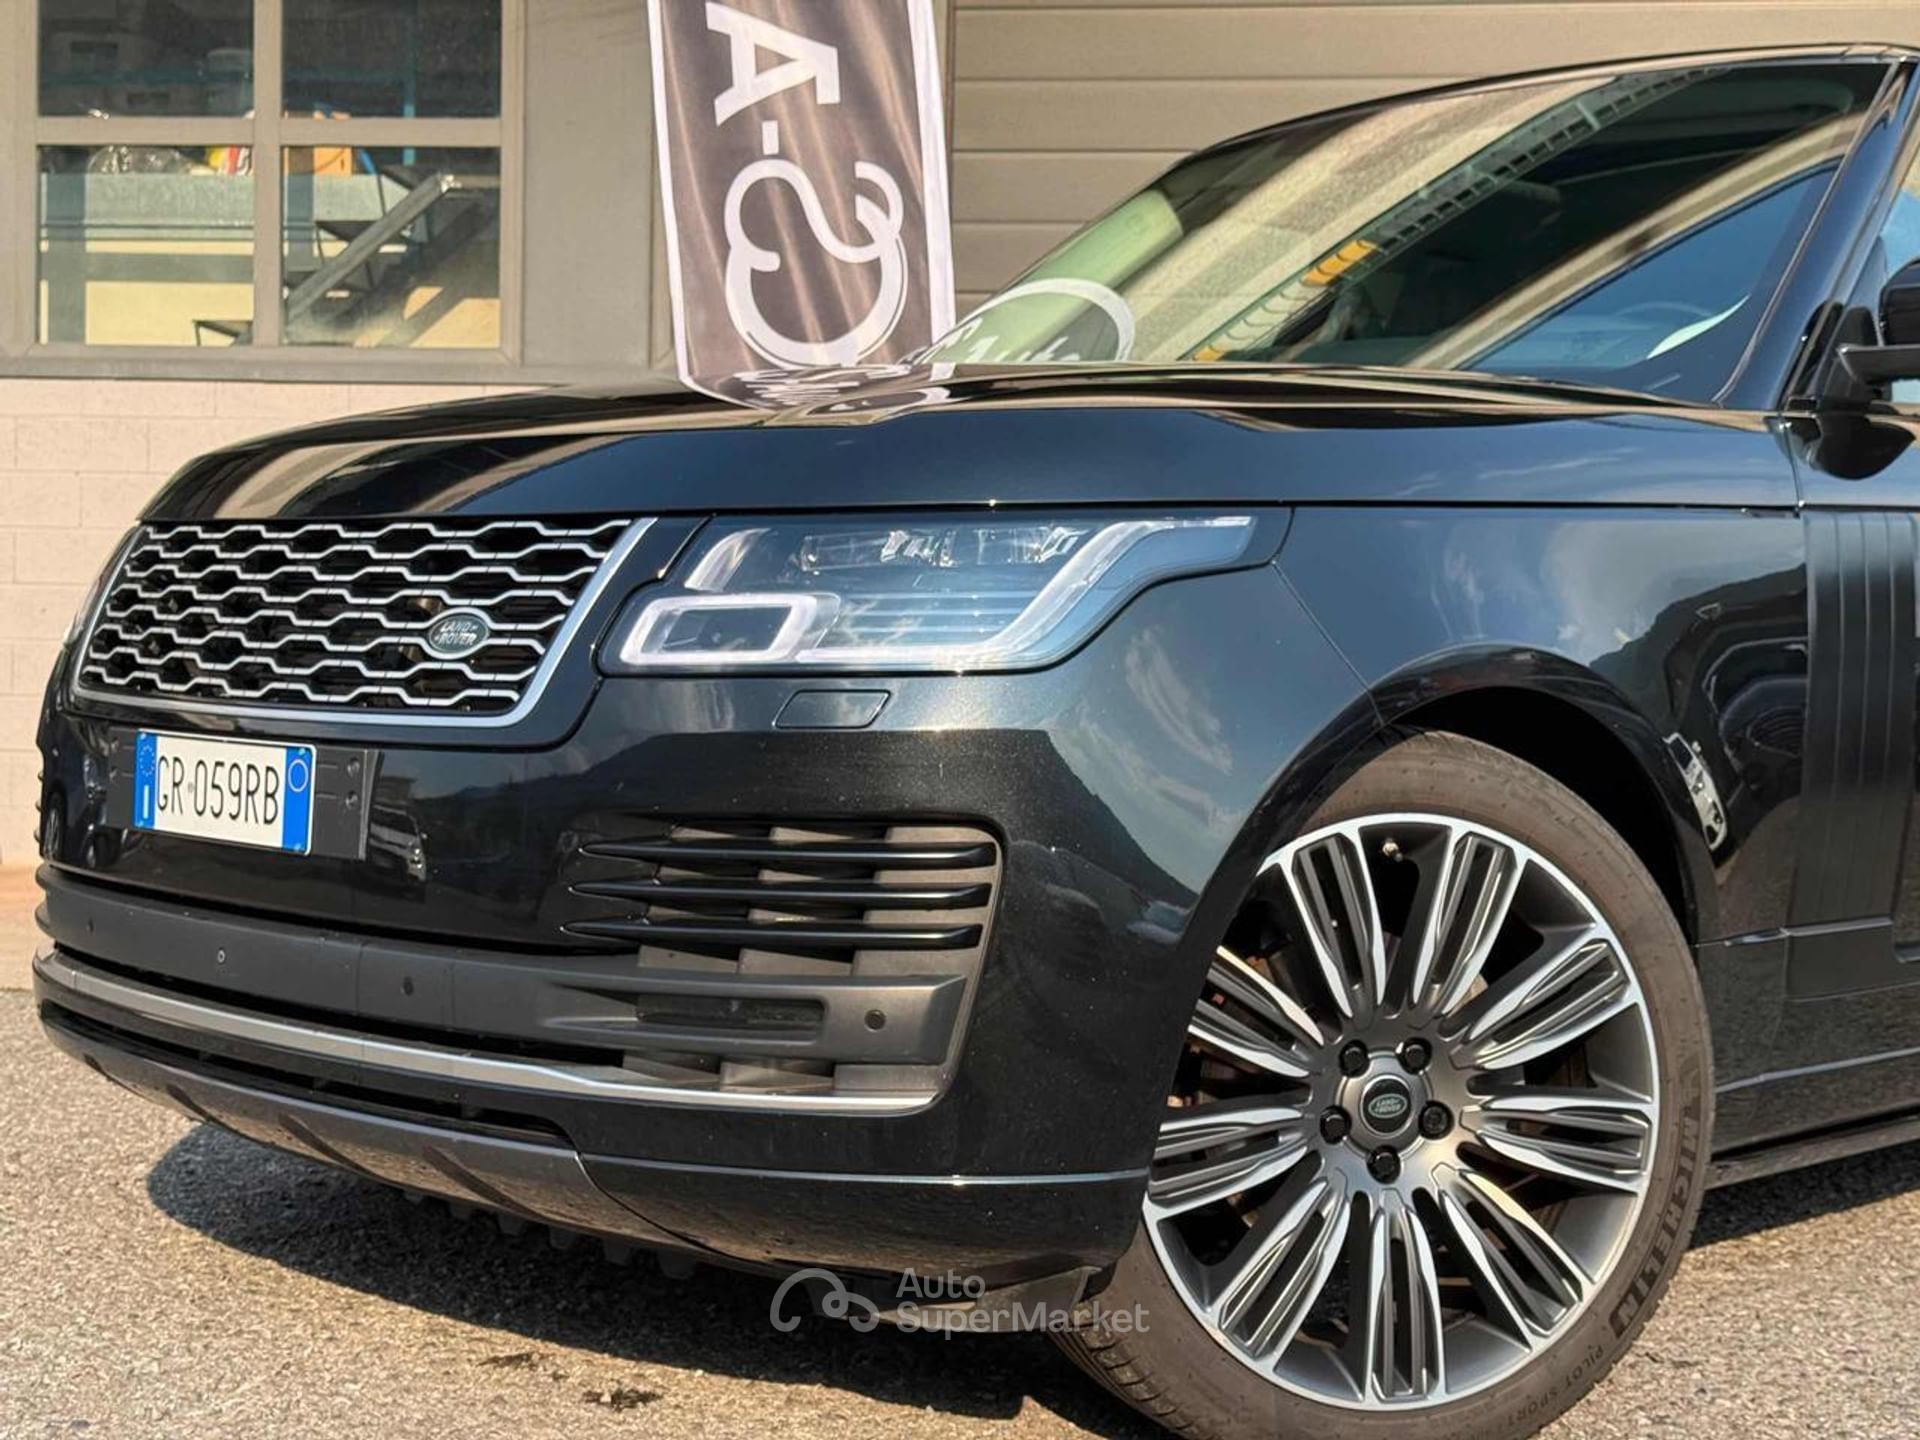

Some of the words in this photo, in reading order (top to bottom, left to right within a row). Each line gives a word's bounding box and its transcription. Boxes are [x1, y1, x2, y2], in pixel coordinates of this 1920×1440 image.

[1614, 1110, 1700, 1328] MICHELIN
[1566, 1344, 1604, 1388] PILOT
[1507, 1390, 1558, 1427] SPORT
